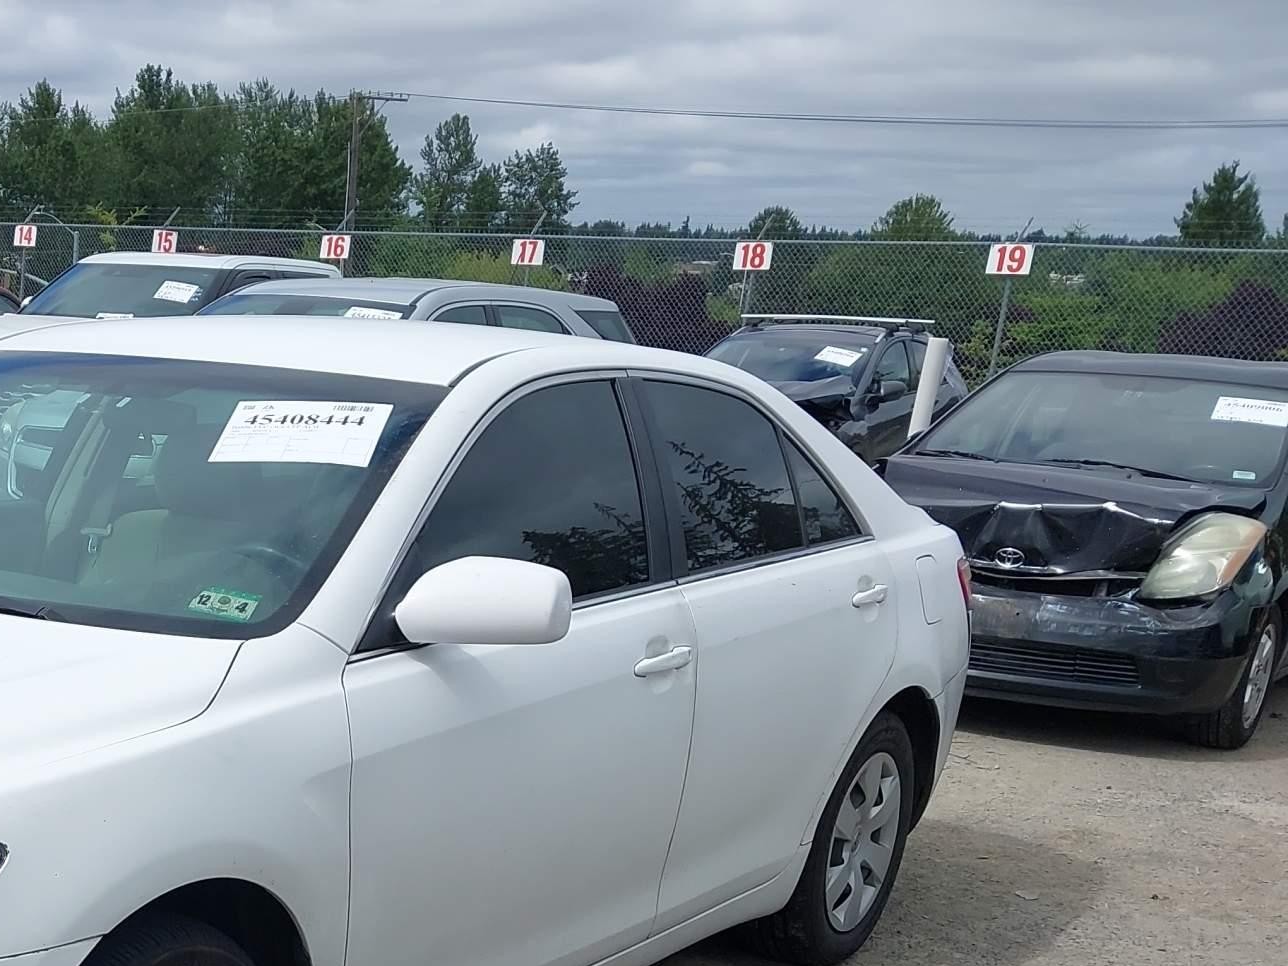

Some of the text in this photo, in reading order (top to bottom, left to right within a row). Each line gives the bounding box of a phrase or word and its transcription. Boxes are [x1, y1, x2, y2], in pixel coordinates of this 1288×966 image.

[19, 226, 32, 245] 14
[157, 231, 173, 252] 15
[326, 236, 345, 257] 16
[519, 240, 538, 263] 17
[741, 243, 767, 269] 18
[995, 245, 1026, 273] 19
[244, 414, 365, 427] 45408444
[197, 593, 211, 606] 12
